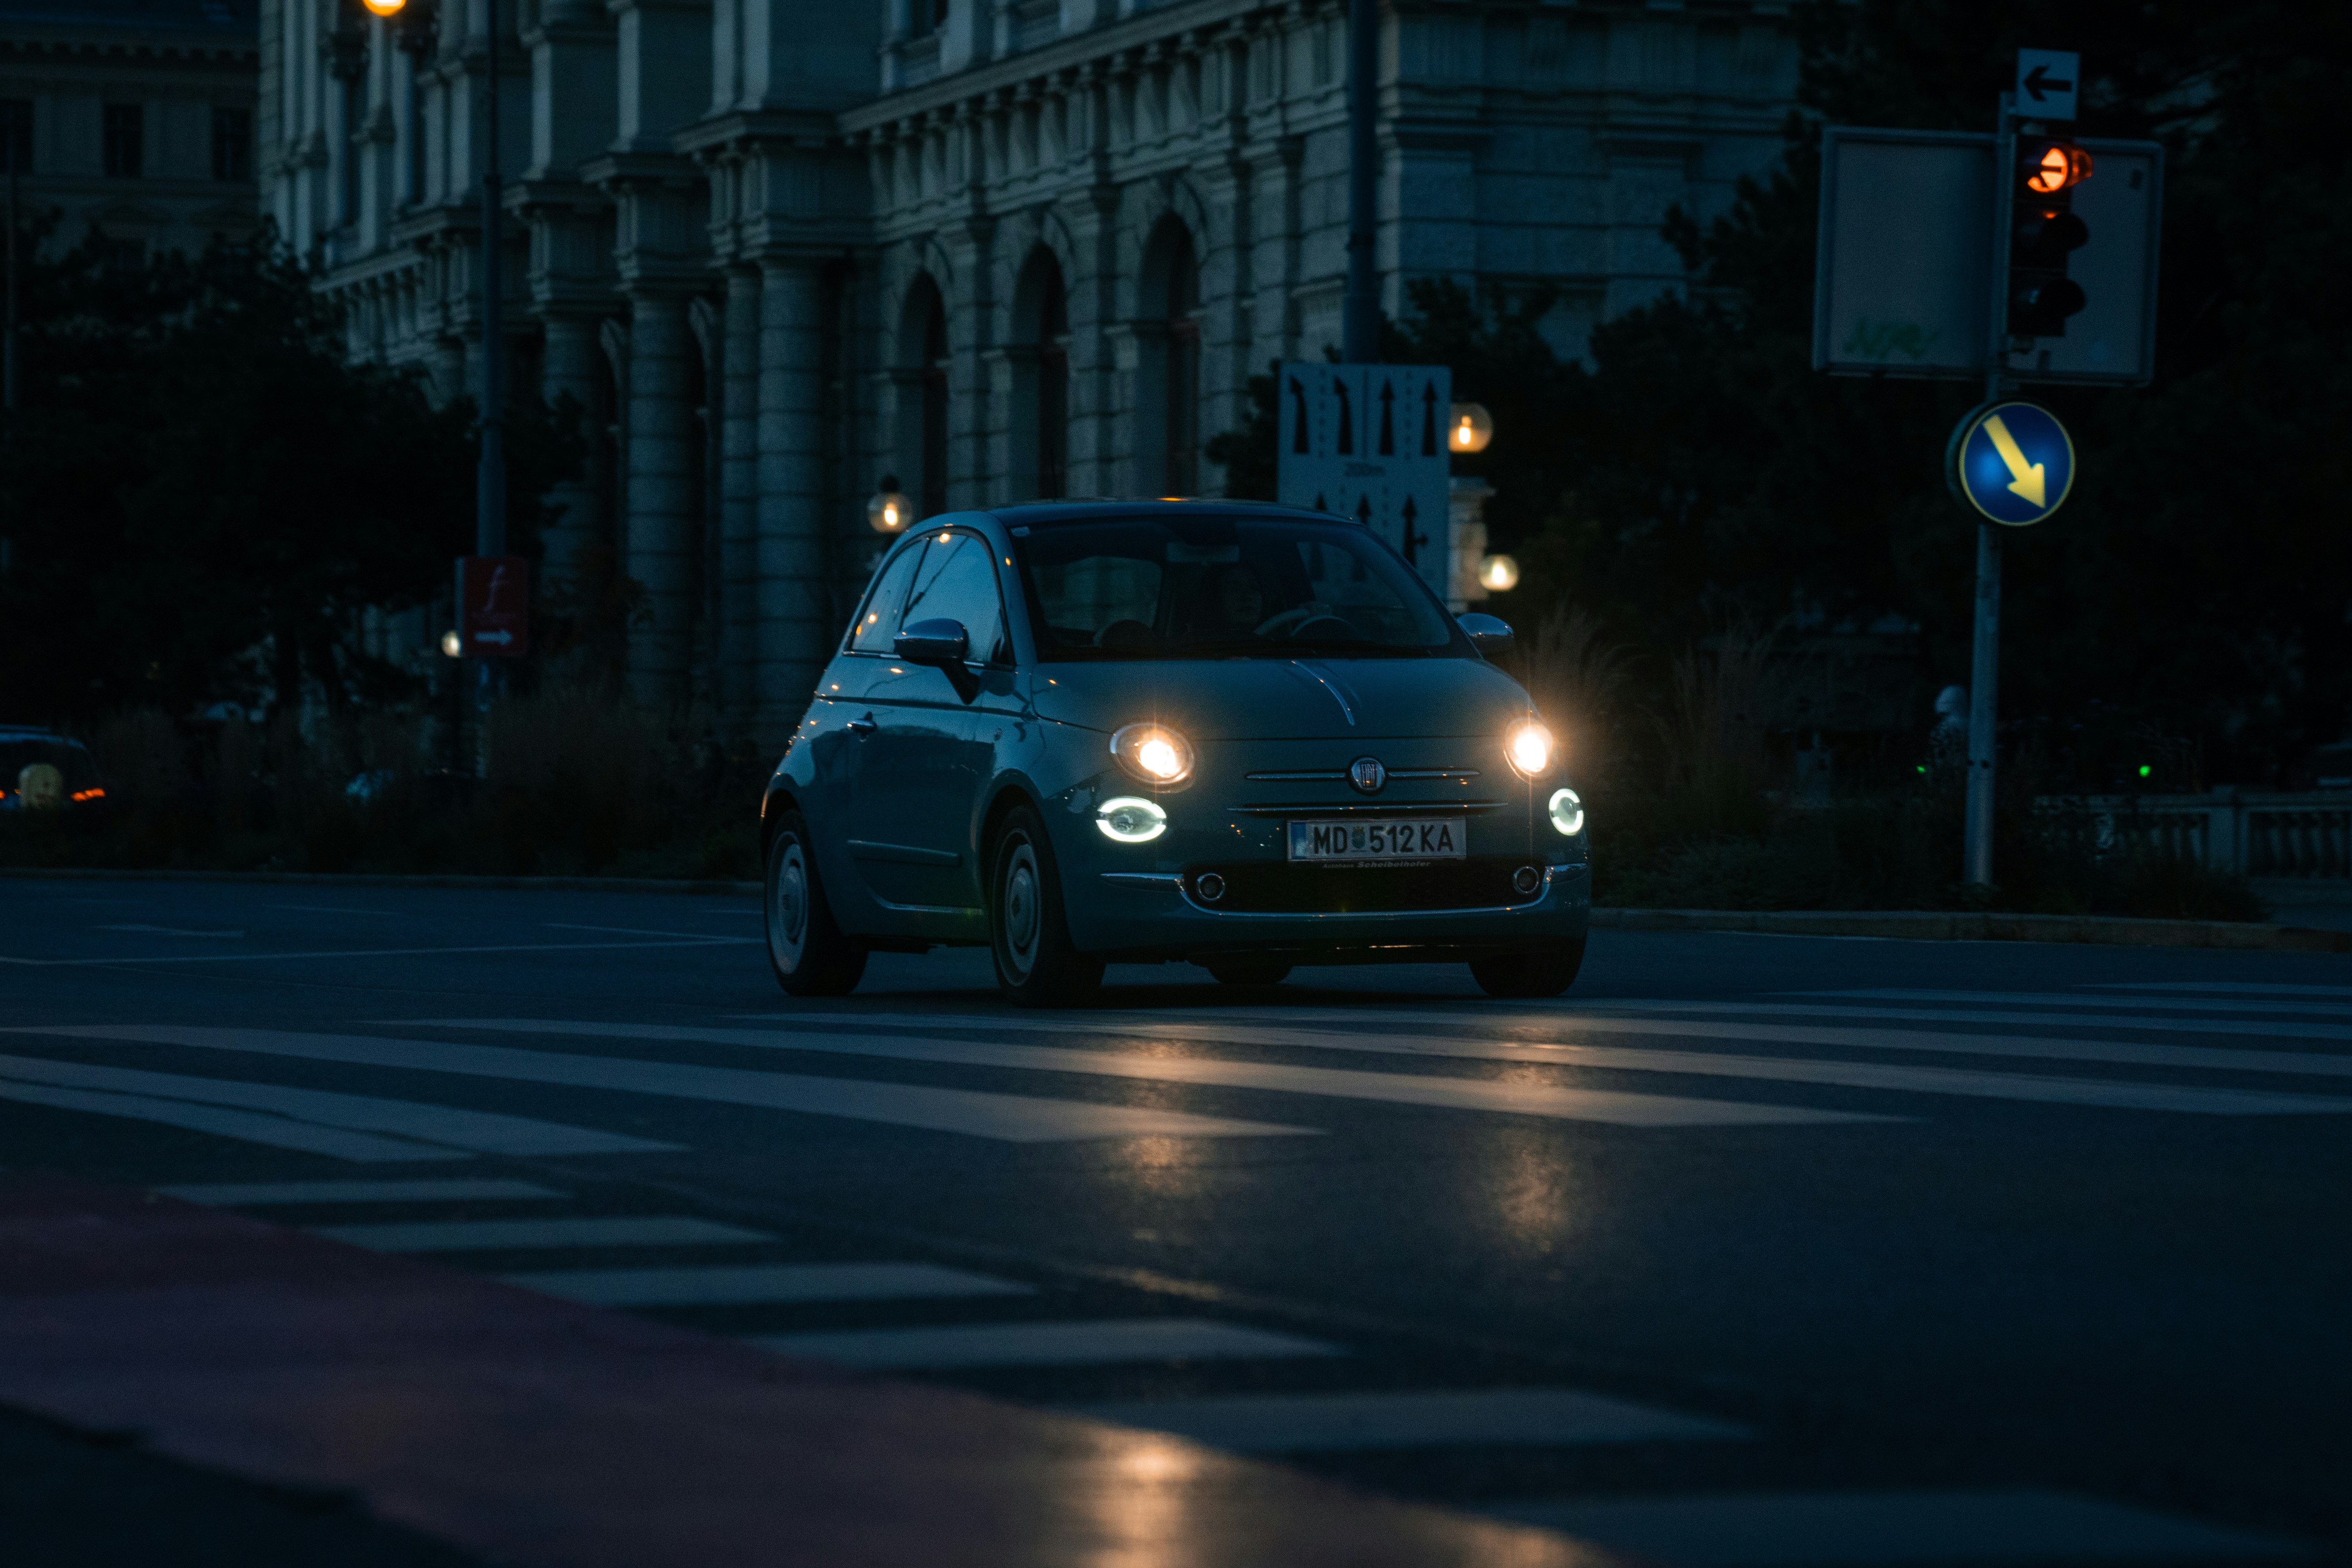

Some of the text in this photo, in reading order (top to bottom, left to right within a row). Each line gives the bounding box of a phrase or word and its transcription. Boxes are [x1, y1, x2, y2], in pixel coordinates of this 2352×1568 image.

[1361, 763, 1376, 787] FIAT
[1313, 824, 1454, 855] MD 512 KA
